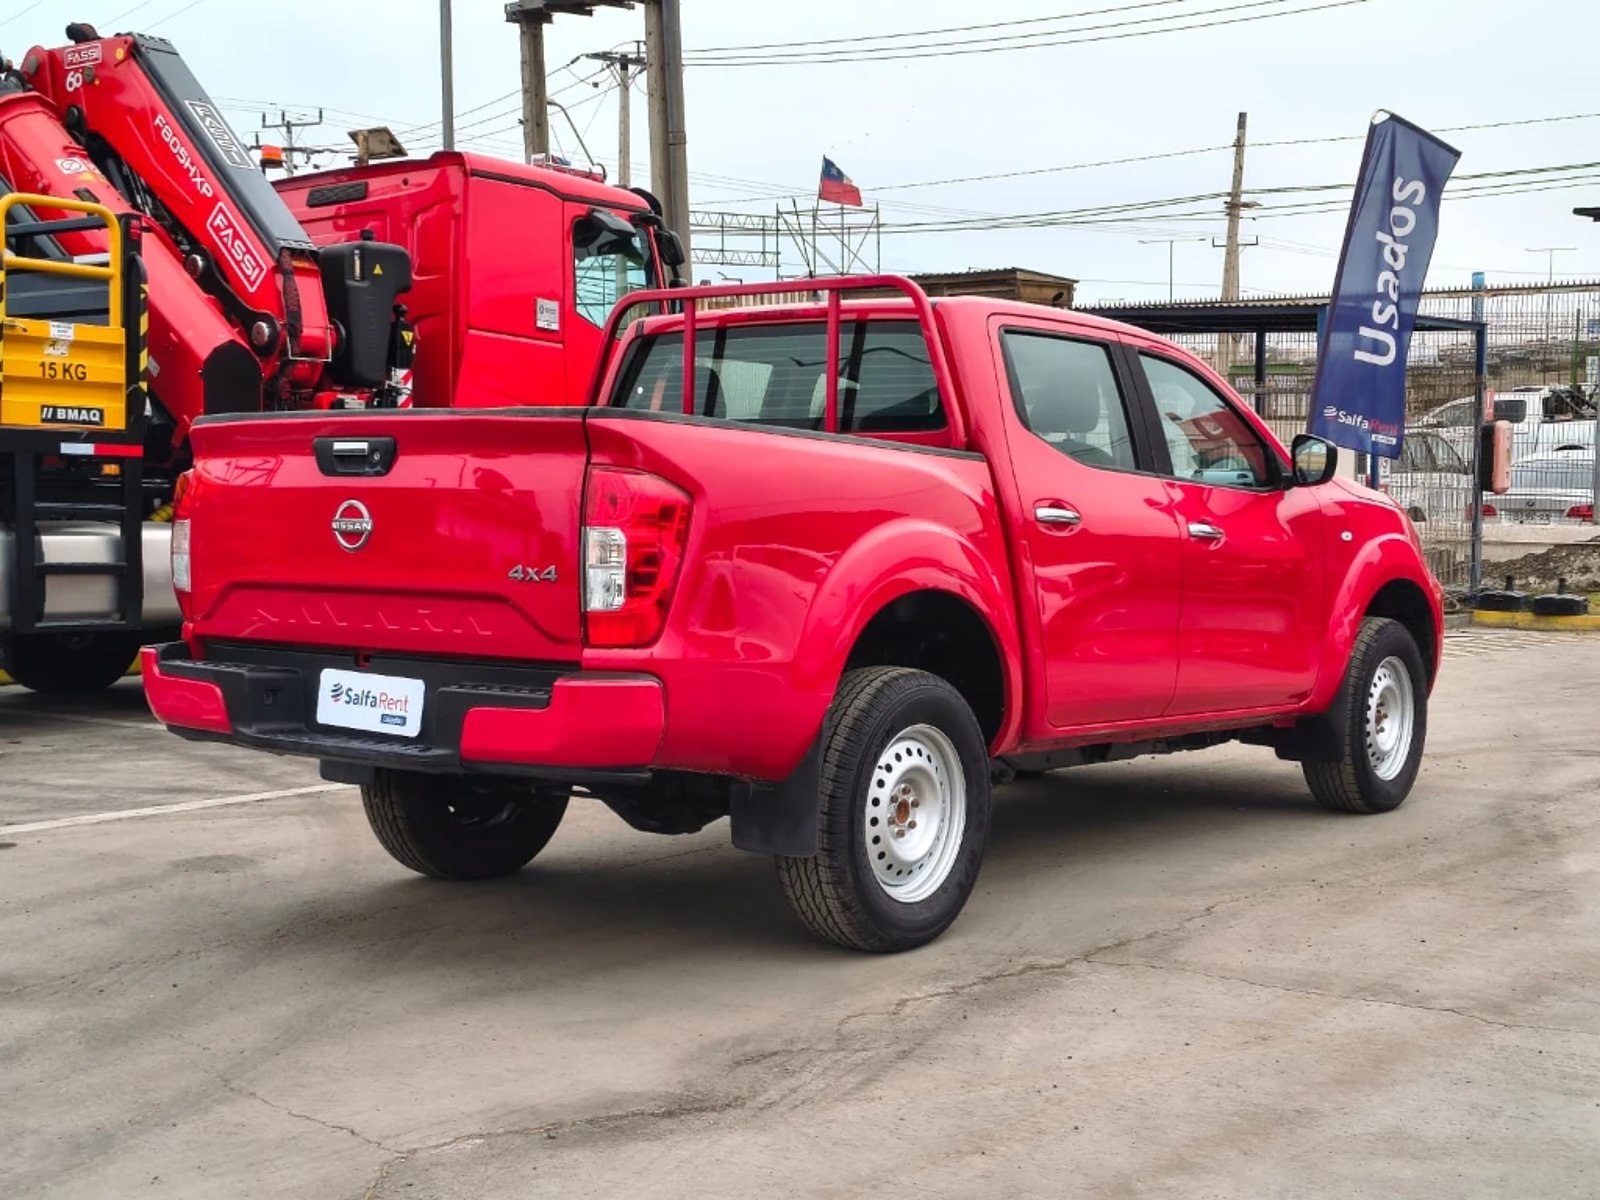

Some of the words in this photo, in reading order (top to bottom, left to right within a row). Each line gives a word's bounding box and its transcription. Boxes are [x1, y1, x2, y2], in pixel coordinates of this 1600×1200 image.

[67, 49, 99, 62] FASSI
[213, 213, 259, 281] FASSI
[1354, 176, 1426, 366] Usados
[39, 361, 57, 379] 15
[62, 362, 87, 381] KG
[57, 407, 101, 424] BMAQ
[332, 520, 371, 531] NISSAN
[508, 564, 558, 582] 4x4
[344, 687, 409, 713] SalfaRent
